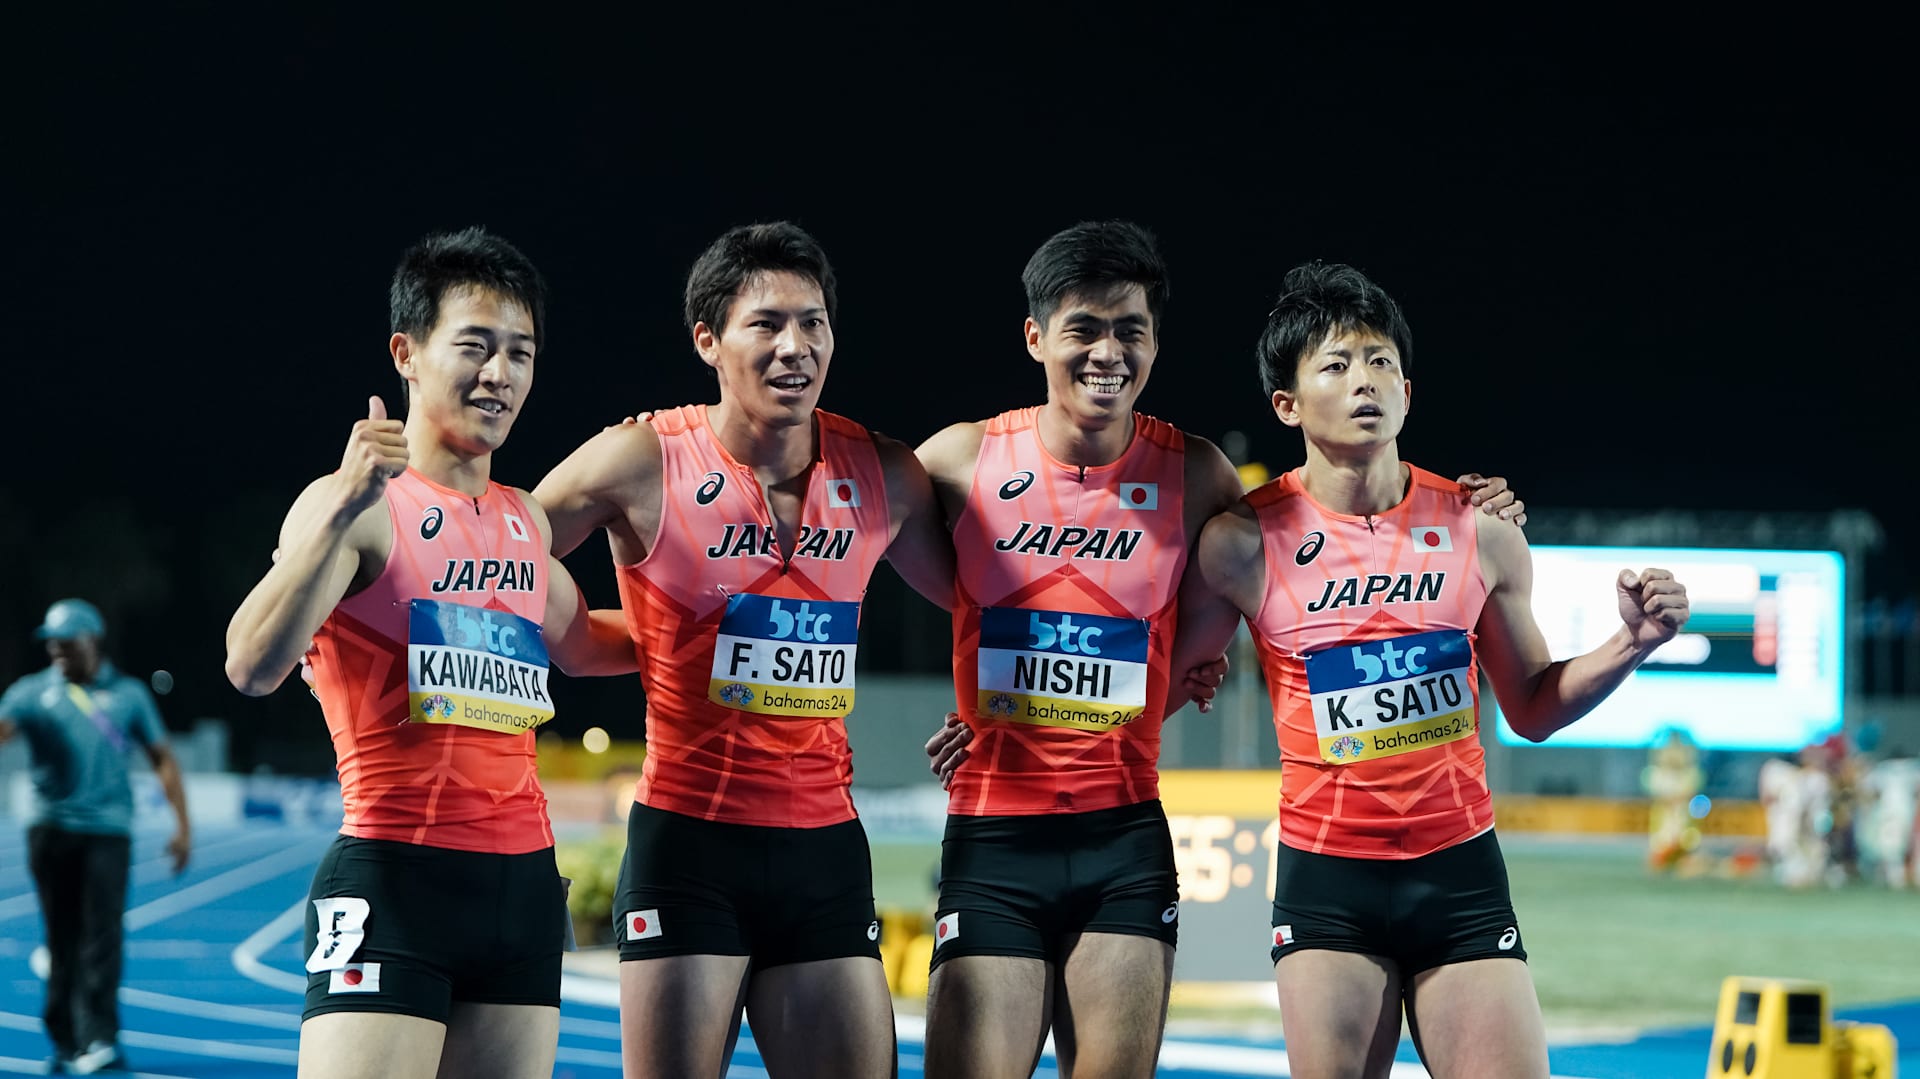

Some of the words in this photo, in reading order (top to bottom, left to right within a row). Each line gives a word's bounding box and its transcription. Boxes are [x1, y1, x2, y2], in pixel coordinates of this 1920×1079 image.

[706, 522, 855, 561] JAPAN
[994, 521, 1144, 562] JAPAN
[430, 558, 537, 593] JAPAN
[1306, 570, 1446, 614] JAPAN
[456, 606, 517, 656] btc
[769, 599, 833, 642] btc
[1029, 611, 1103, 655] btc
[419, 650, 548, 703] KAWABATA
[729, 642, 759, 679] F.
[772, 646, 846, 684] SATO
[1013, 655, 1112, 699] NISHI
[1351, 640, 1428, 684] btc
[763, 690, 847, 710] bahamas24
[1027, 701, 1131, 726] bahamas24
[1327, 695, 1363, 731] K.
[1374, 673, 1462, 723] SATO
[1373, 715, 1470, 751] bahamas24
